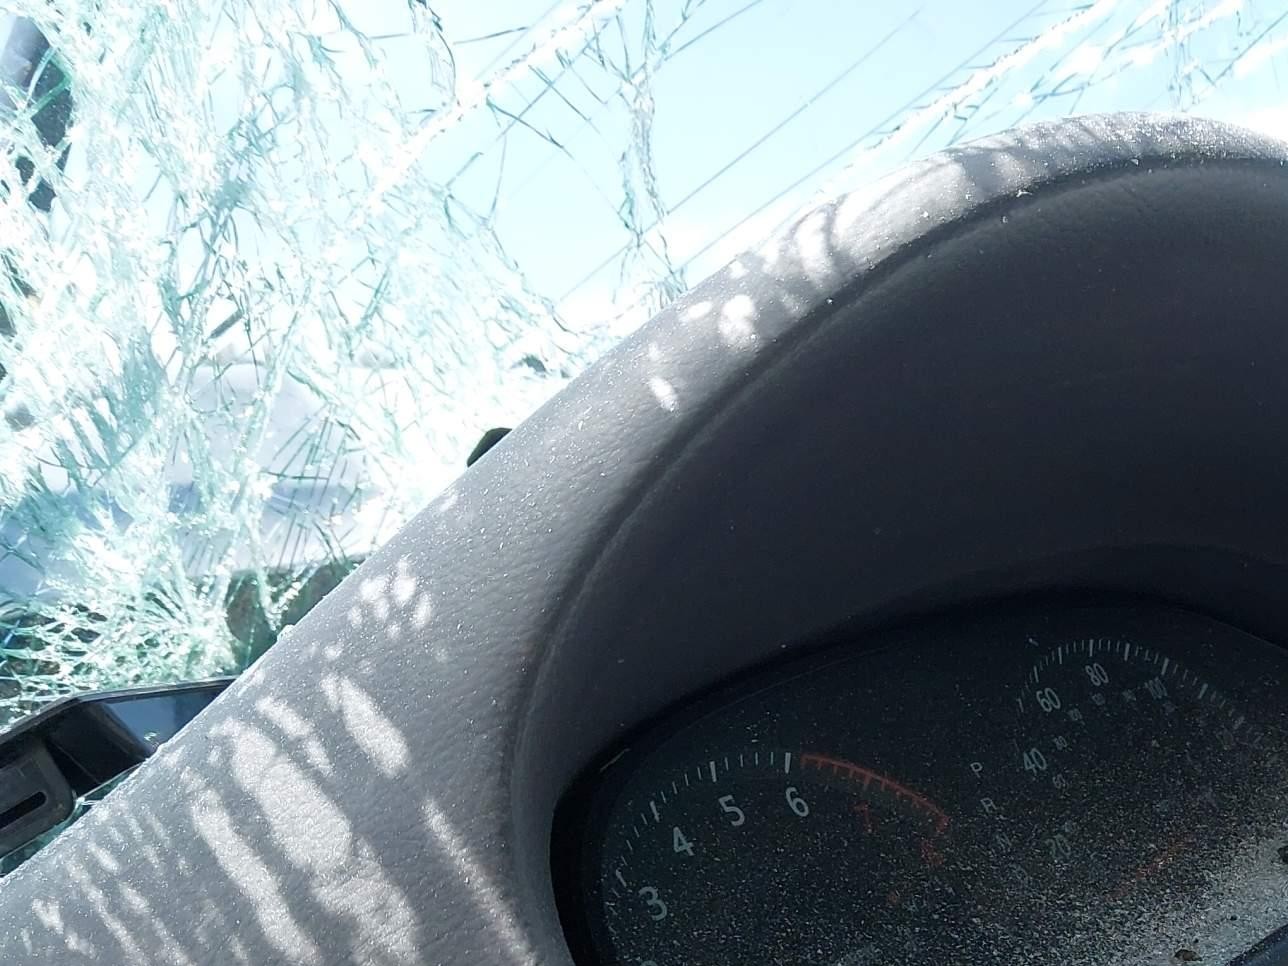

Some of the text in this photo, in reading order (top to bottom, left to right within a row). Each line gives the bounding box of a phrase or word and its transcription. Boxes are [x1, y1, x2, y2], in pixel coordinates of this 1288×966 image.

[1085, 662, 1110, 687] 80
[1036, 687, 1062, 713] 60
[969, 761, 984, 778] P
[1023, 748, 1048, 776] 40
[718, 795, 745, 826] 5
[786, 787, 809, 817] 6
[980, 797, 999, 815] R
[672, 827, 694, 856] 4
[638, 886, 668, 921] 3
